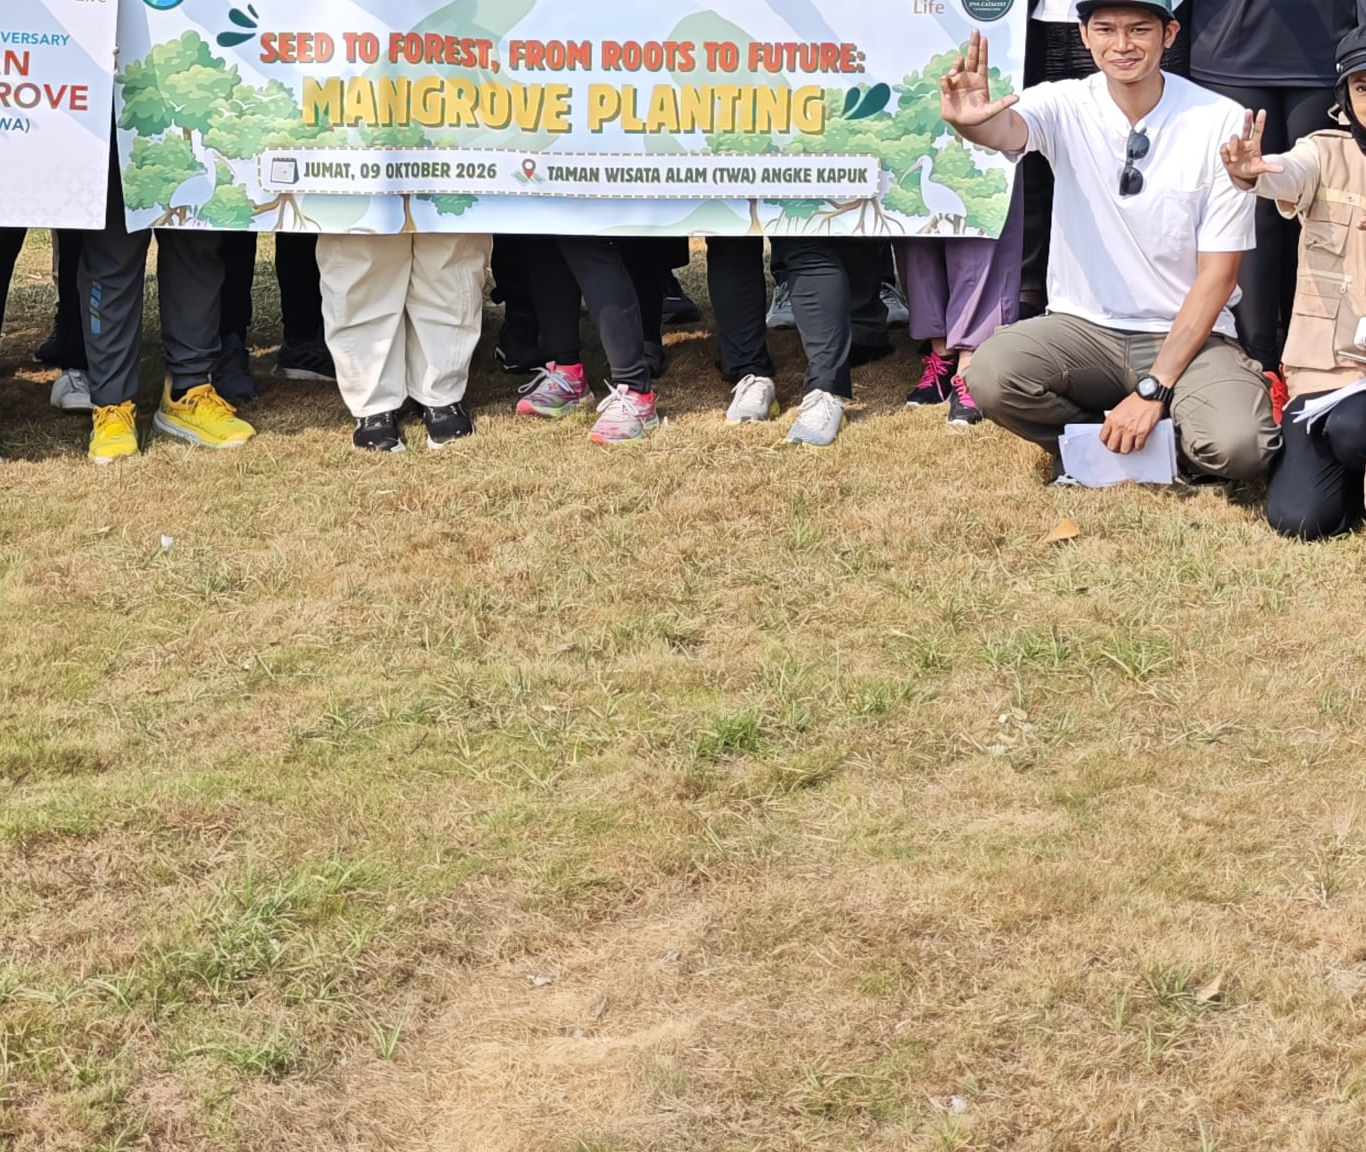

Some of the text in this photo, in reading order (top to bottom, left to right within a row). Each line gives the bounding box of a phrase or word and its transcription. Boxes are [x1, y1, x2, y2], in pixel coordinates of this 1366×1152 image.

[913, 0, 945, 14] Life
[260, 32, 867, 74] SEED TO FOREST, FROM ROOTS TO FUTURE:
[301, 75, 827, 136] MANGROVE PLANTING
[303, 161, 497, 183] JUMAT, 09 OKTOBER 2026
[547, 166, 868, 186] TAMAN WISATA ALAM (TWA) ANGKE KAPUK
